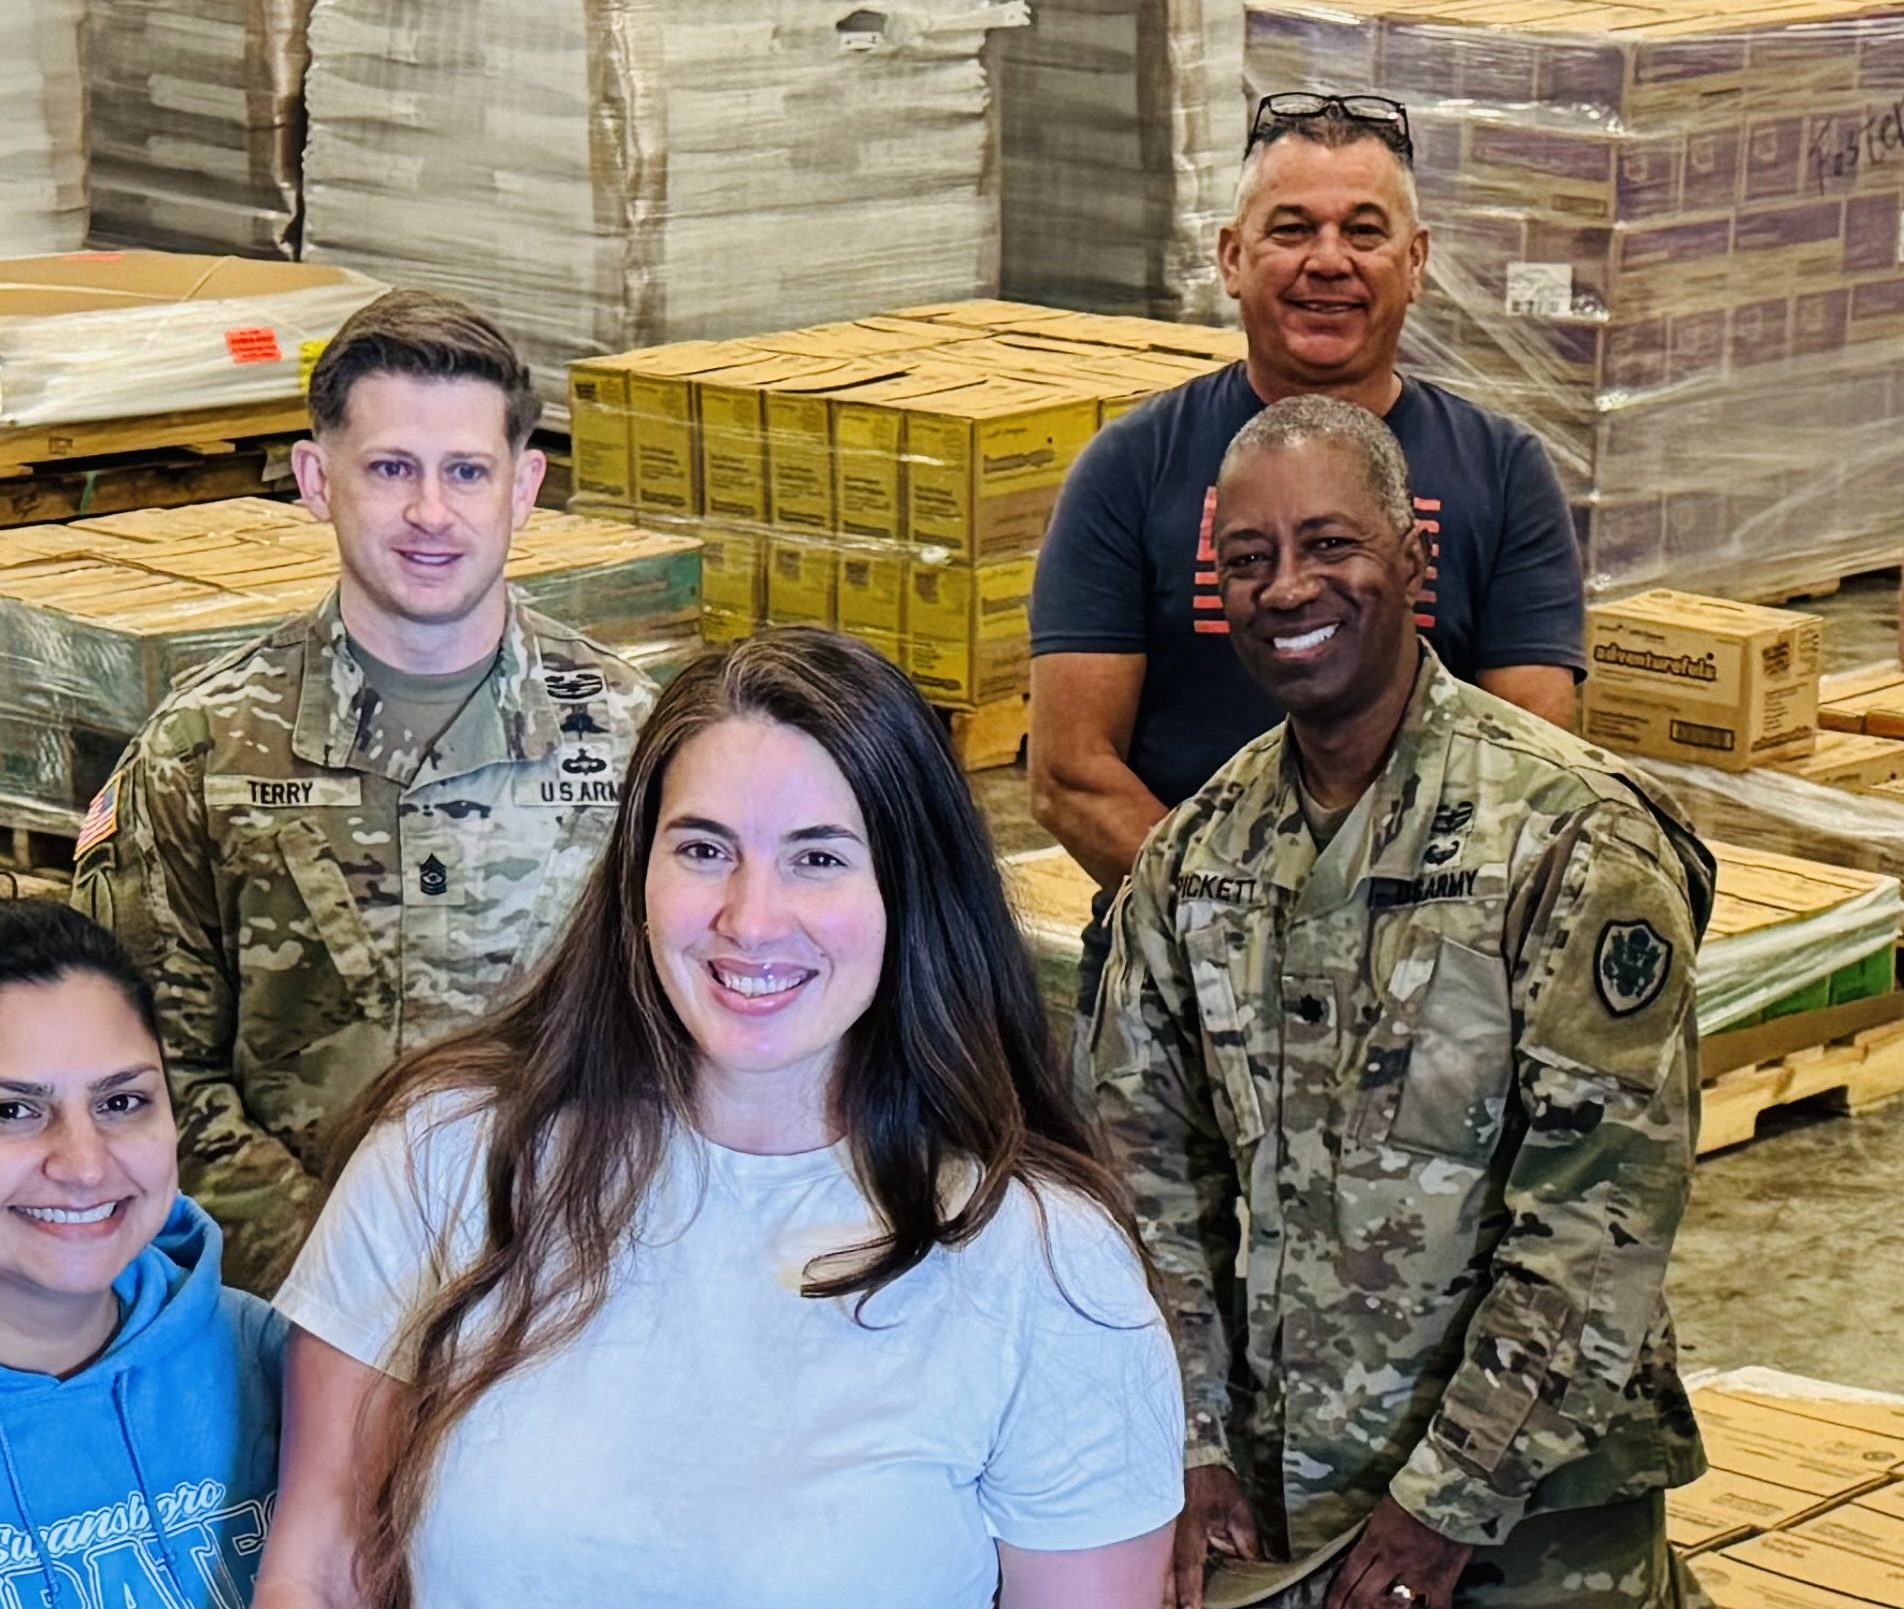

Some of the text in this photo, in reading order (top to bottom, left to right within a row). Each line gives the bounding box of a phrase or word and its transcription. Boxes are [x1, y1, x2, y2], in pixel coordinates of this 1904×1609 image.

[1594, 643, 1716, 681] adventurefuls
[246, 780, 314, 805] TERRY
[578, 780, 619, 802] ARM
[1426, 869, 1479, 898] ARMY
